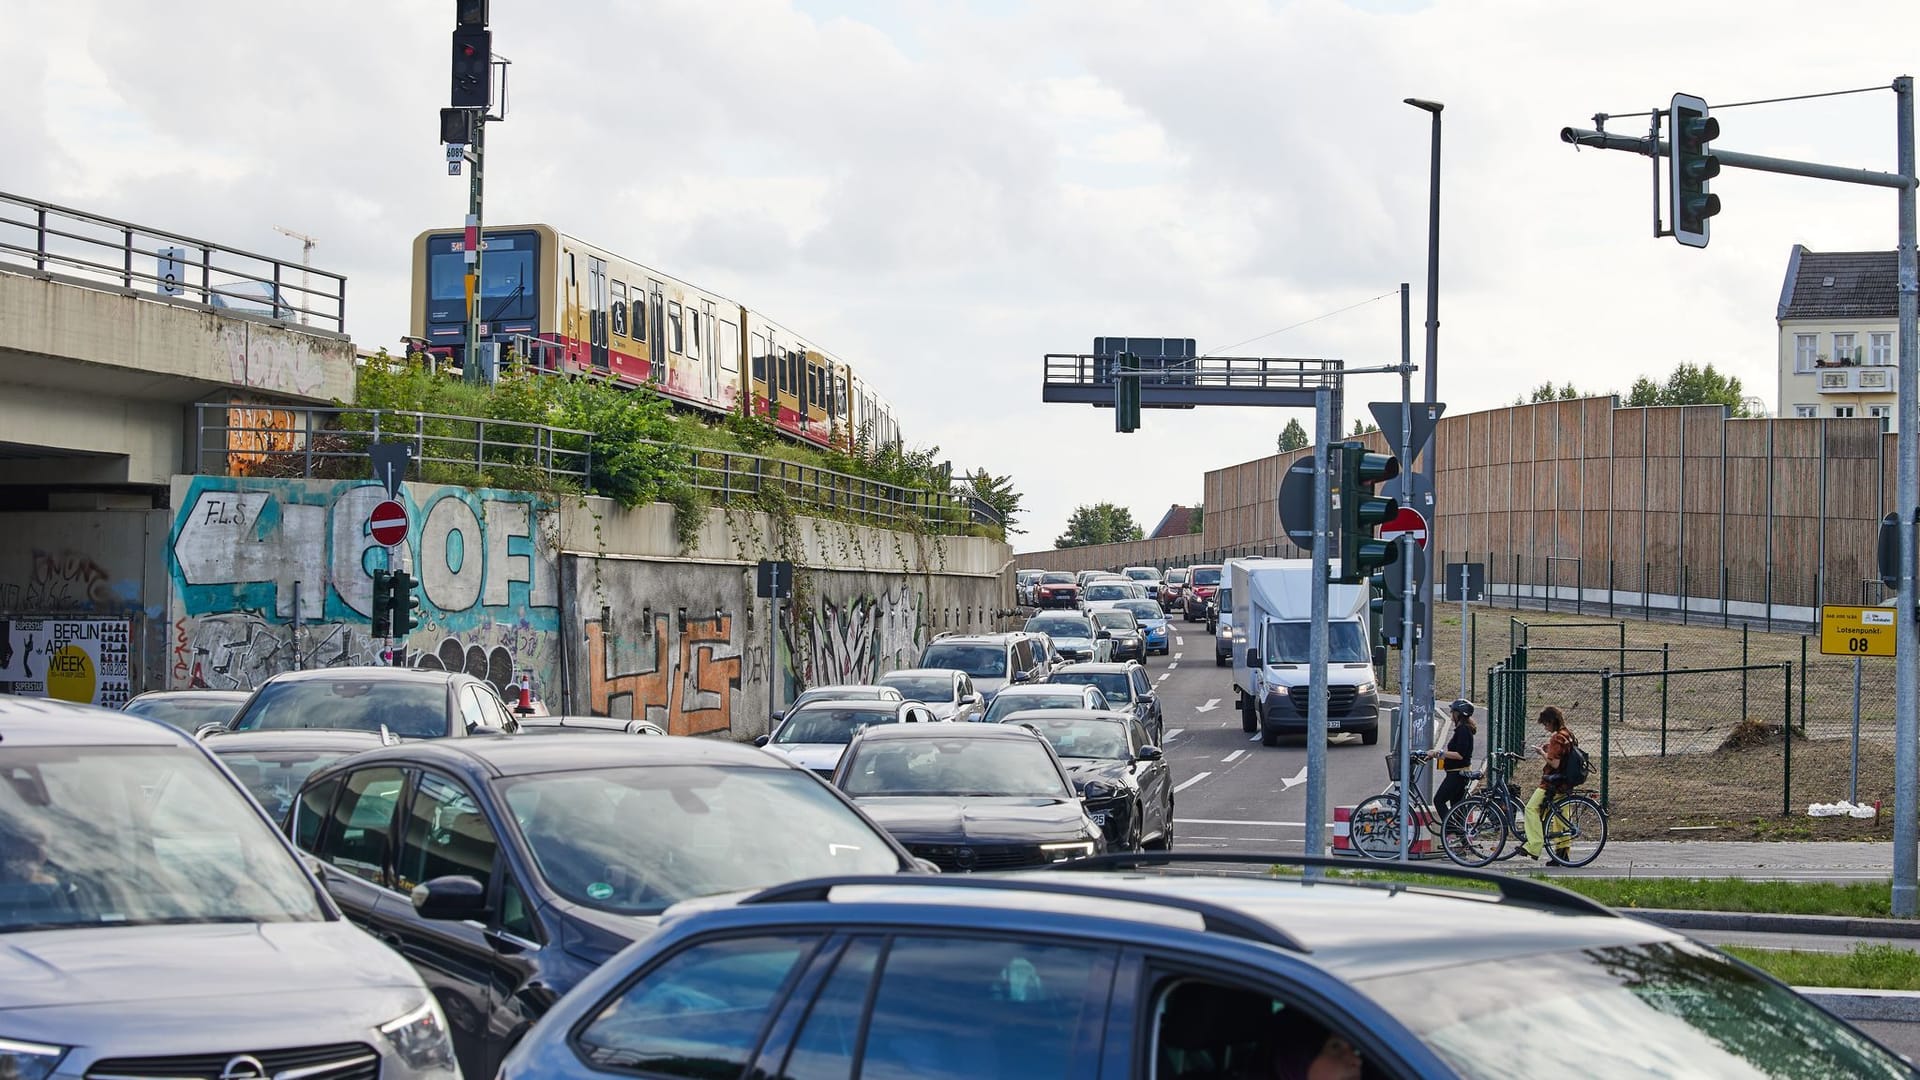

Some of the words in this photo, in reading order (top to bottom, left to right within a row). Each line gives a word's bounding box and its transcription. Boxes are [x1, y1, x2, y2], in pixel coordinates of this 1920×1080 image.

[54, 624, 100, 640] BERLIN
[45, 640, 71, 655] ART
[1849, 637, 1868, 652] 08
[49, 655, 86, 672] WEEK
